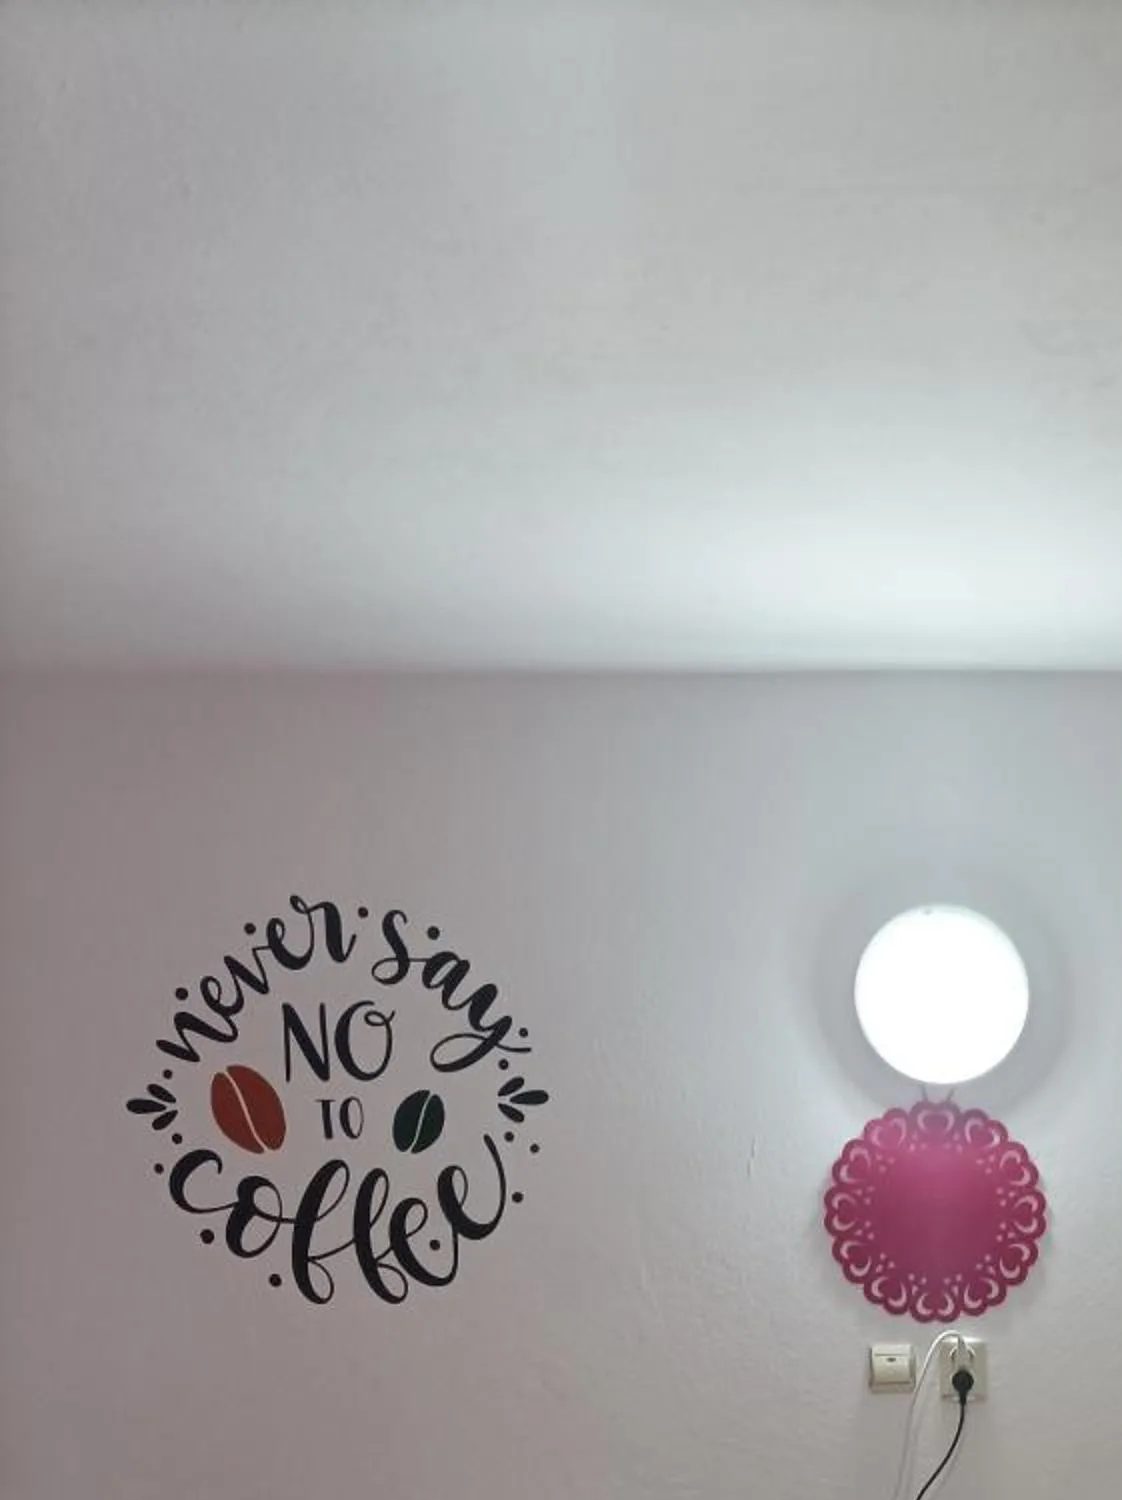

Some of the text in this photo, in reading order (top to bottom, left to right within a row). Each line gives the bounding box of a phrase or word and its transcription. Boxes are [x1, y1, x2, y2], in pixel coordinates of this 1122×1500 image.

[155, 894, 532, 1073] never say
[281, 1000, 396, 1083] NO
[315, 1096, 365, 1140] TO
[168, 1133, 507, 1305] coffee
